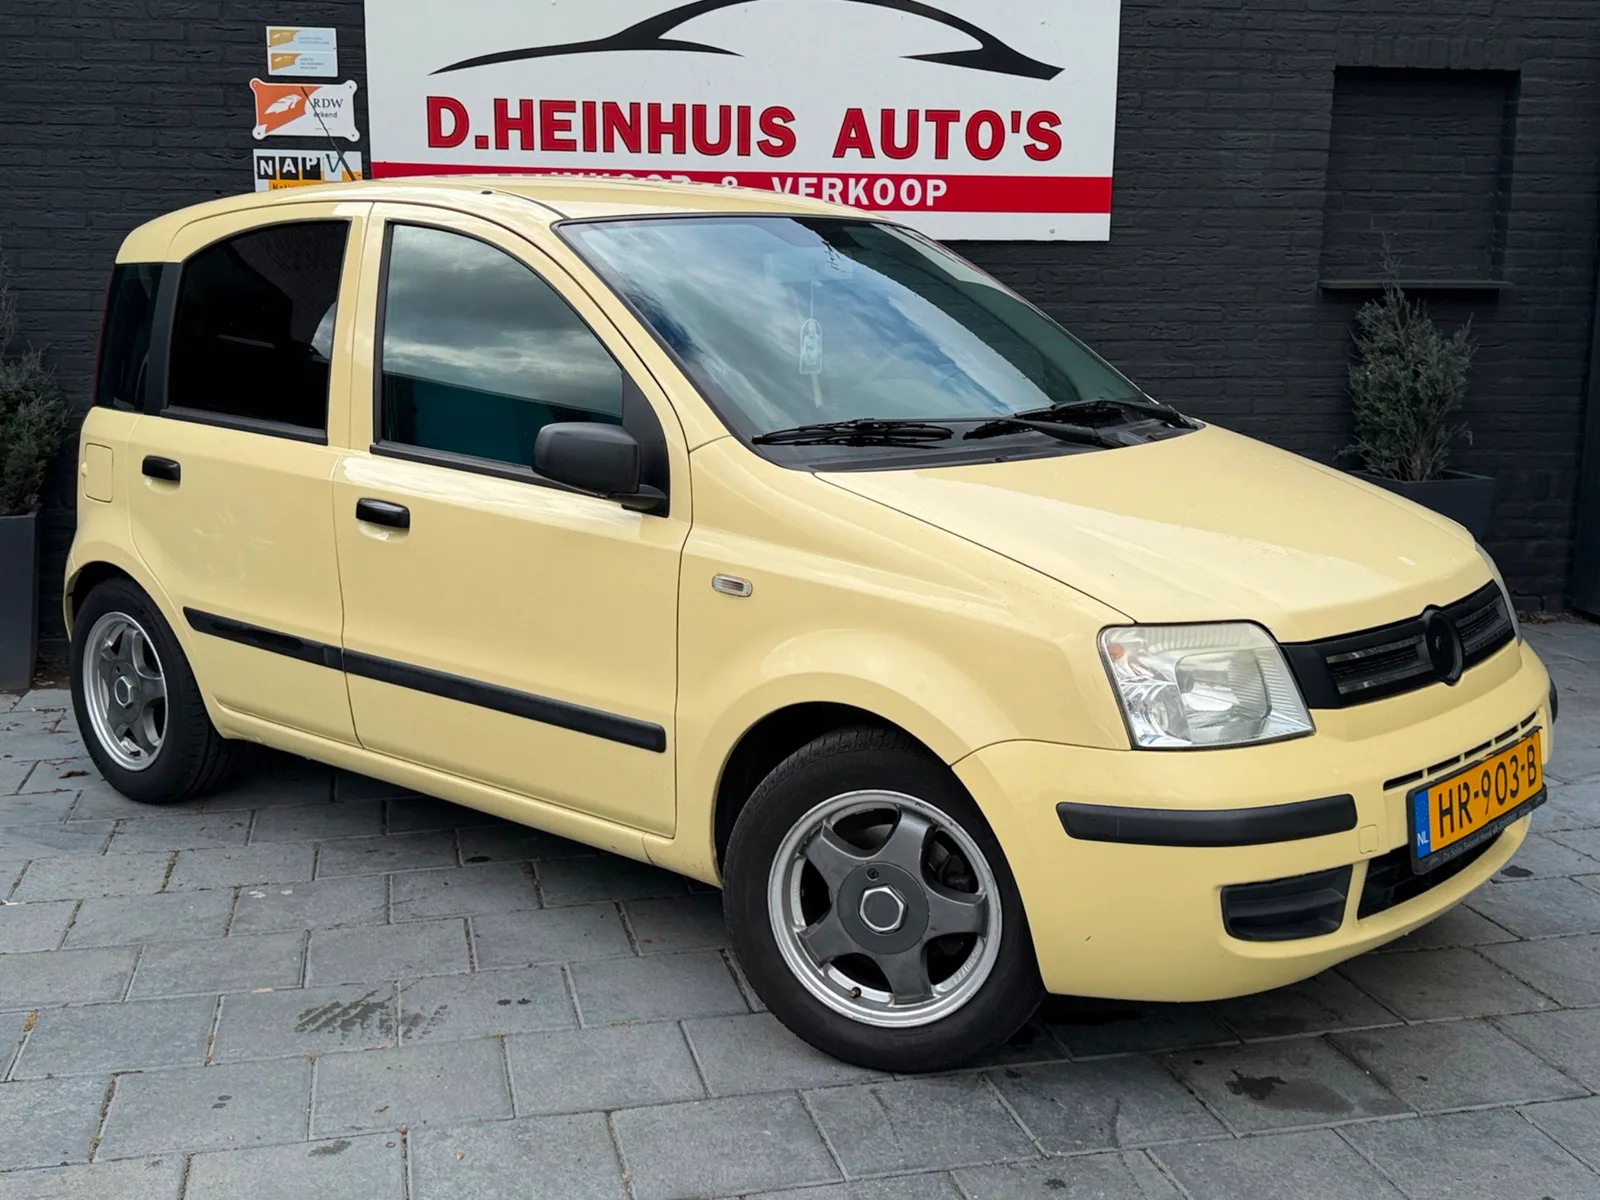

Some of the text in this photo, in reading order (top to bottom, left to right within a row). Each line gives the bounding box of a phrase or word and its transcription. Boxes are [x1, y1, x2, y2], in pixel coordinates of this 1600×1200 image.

[313, 98, 344, 109] RDW
[313, 110, 338, 119] erkend
[426, 95, 1063, 162] D.HEINHUIS AUTO'S
[771, 176, 948, 207] VERKOOP
[1438, 745, 1537, 838] HR-903-B
[1416, 830, 1429, 847] NL
